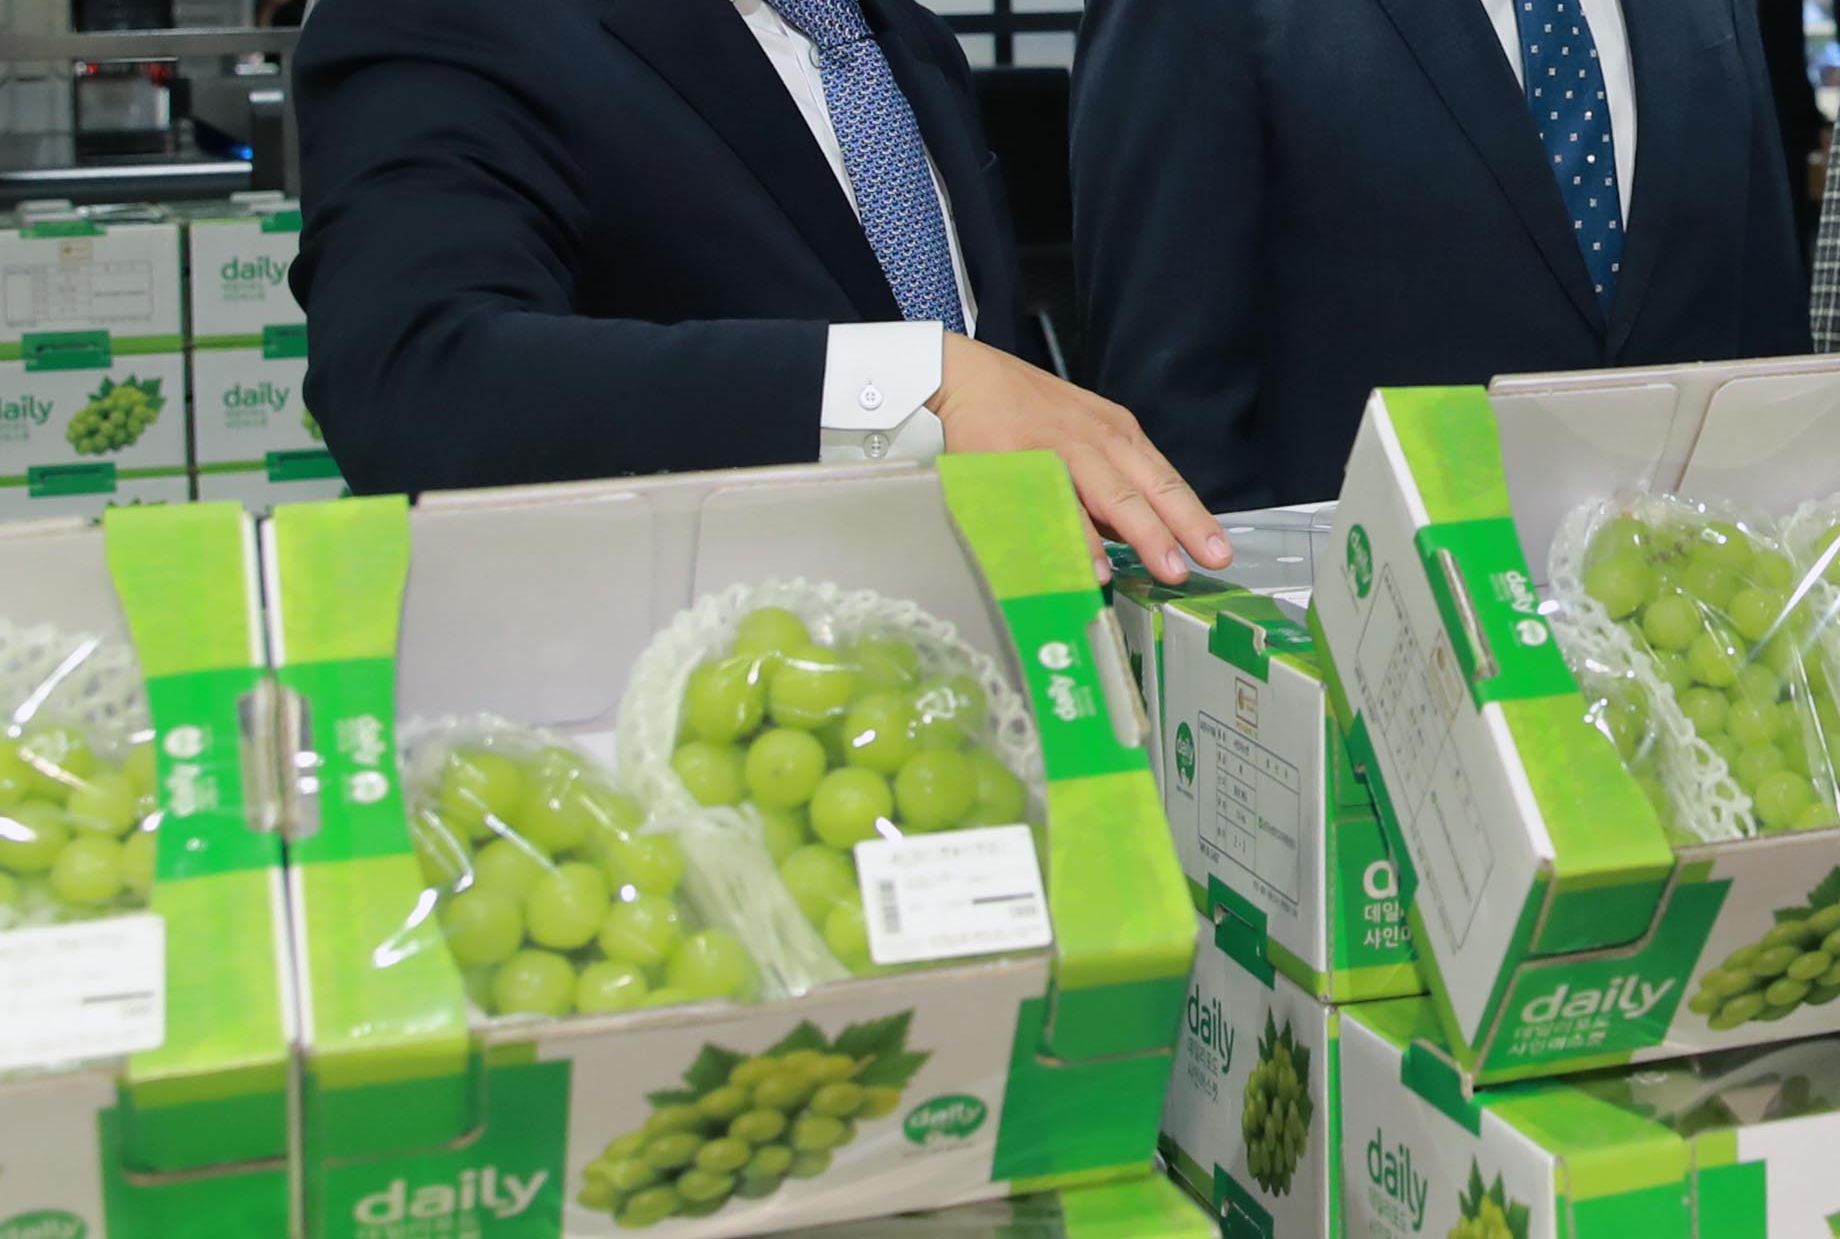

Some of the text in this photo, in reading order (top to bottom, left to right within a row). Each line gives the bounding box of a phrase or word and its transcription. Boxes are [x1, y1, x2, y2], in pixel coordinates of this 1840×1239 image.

[221, 256, 288, 285] daily
[223, 381, 291, 411] daily
[1521, 974, 1677, 1024] daily
[1188, 982, 1235, 1075] daily
[353, 1164, 550, 1226] daily
[1367, 1126, 1429, 1233] daily
